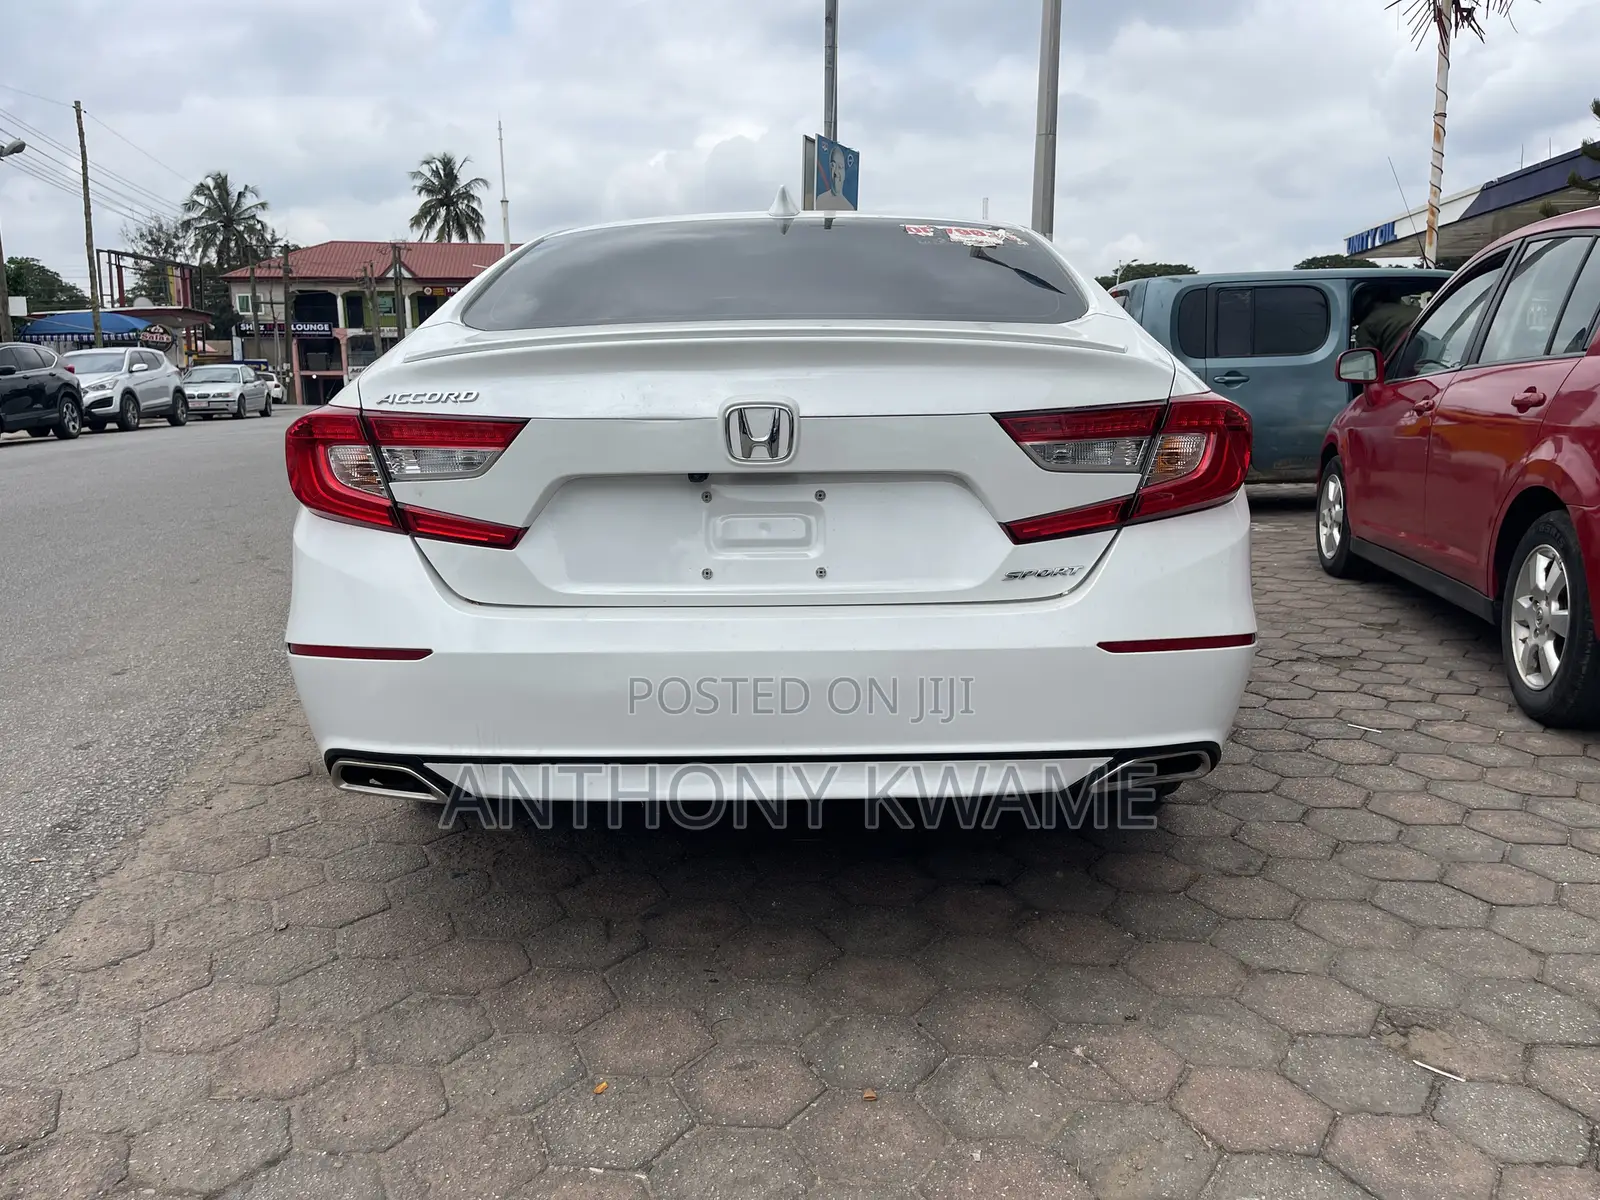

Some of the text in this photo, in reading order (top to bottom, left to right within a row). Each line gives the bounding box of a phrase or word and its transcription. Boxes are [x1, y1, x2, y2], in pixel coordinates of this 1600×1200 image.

[1347, 221, 1397, 255] UNITY OIL
[290, 323, 330, 331] LOUNGE
[376, 390, 480, 406] ACCORD
[1001, 565, 1085, 582] SPORT
